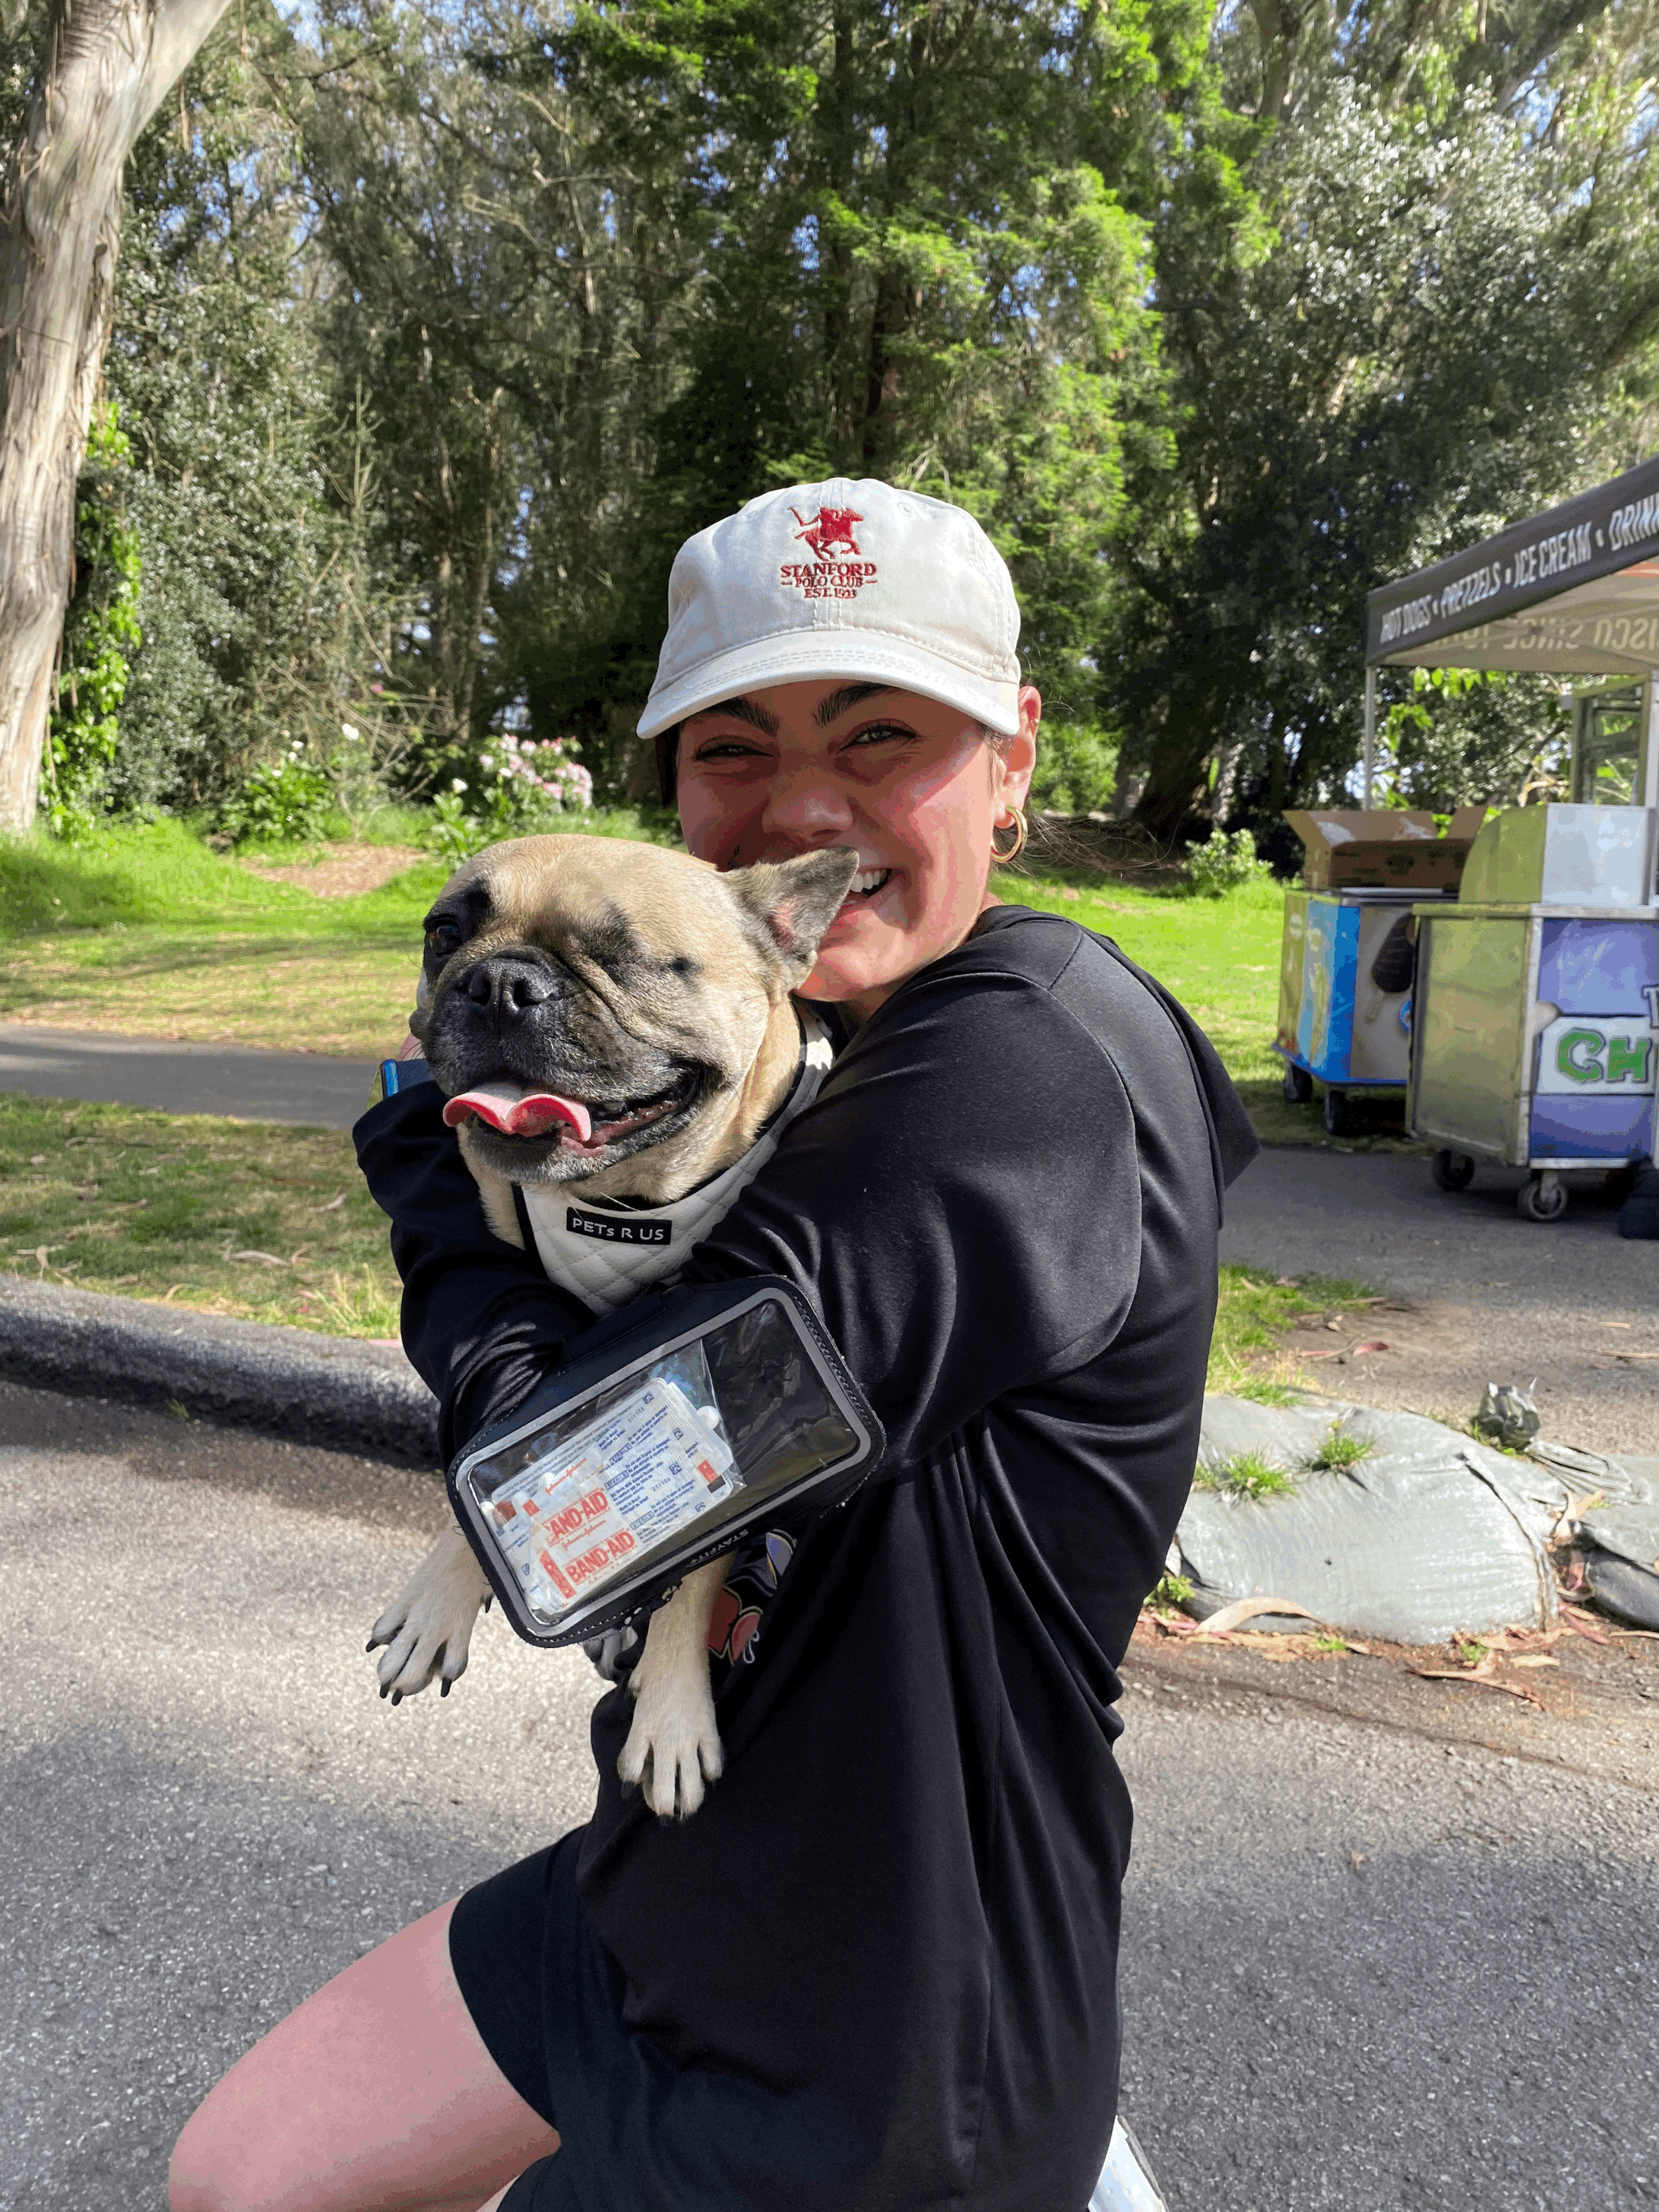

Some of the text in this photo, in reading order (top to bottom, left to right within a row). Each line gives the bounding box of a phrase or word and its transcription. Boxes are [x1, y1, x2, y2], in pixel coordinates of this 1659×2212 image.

[780, 562, 877, 577] STANFORD
[794, 575, 863, 588] POLO CLUB
[1441, 561, 1501, 619] PRETZELS
[1514, 545, 1536, 589] ICE
[1539, 520, 1592, 579] CREAM
[621, 1228, 633, 1238] R
[640, 1228, 664, 1240] US
[543, 1491, 609, 1539] AND-AID
[565, 1531, 634, 1582] BAND-AID
